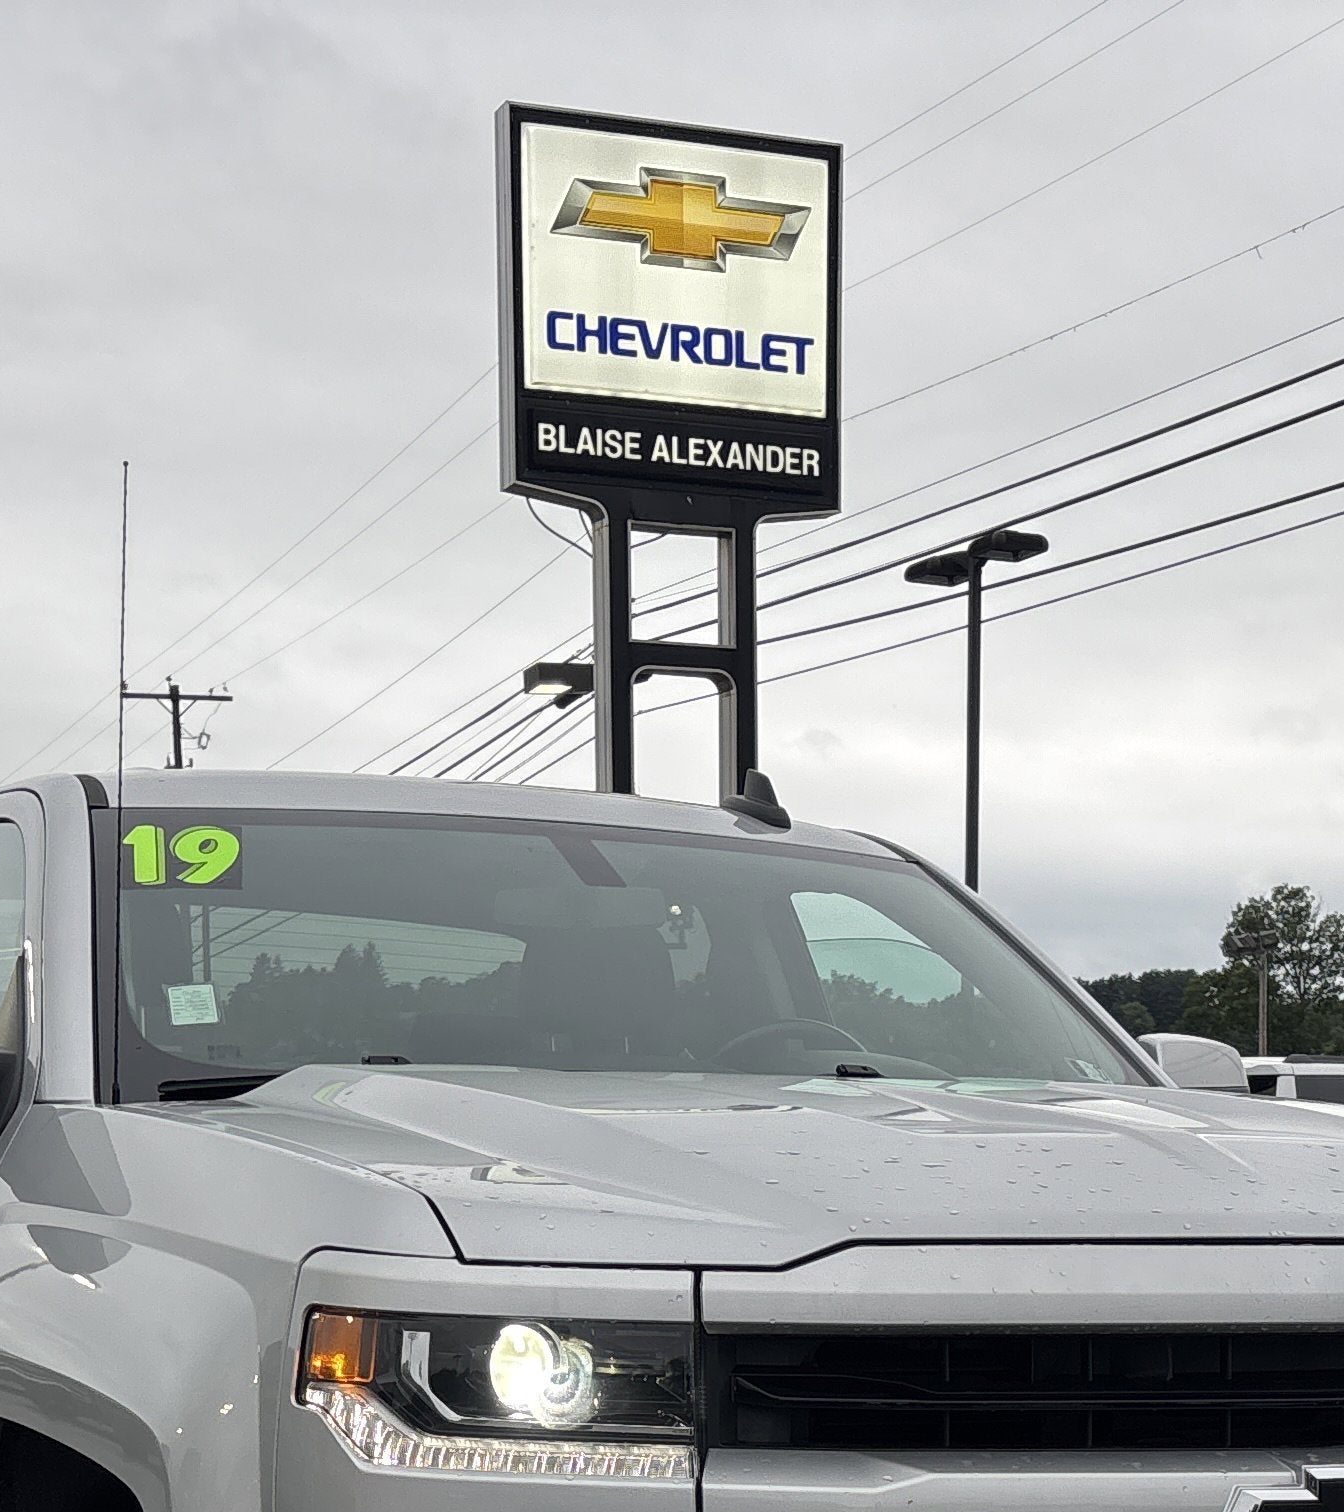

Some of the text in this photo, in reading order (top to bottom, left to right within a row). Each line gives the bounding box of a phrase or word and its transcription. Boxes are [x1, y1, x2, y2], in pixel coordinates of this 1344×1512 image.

[546, 311, 815, 375] CHEVROLET
[537, 422, 820, 477] BLAISE ALEXANDER
[122, 825, 240, 885] 19
